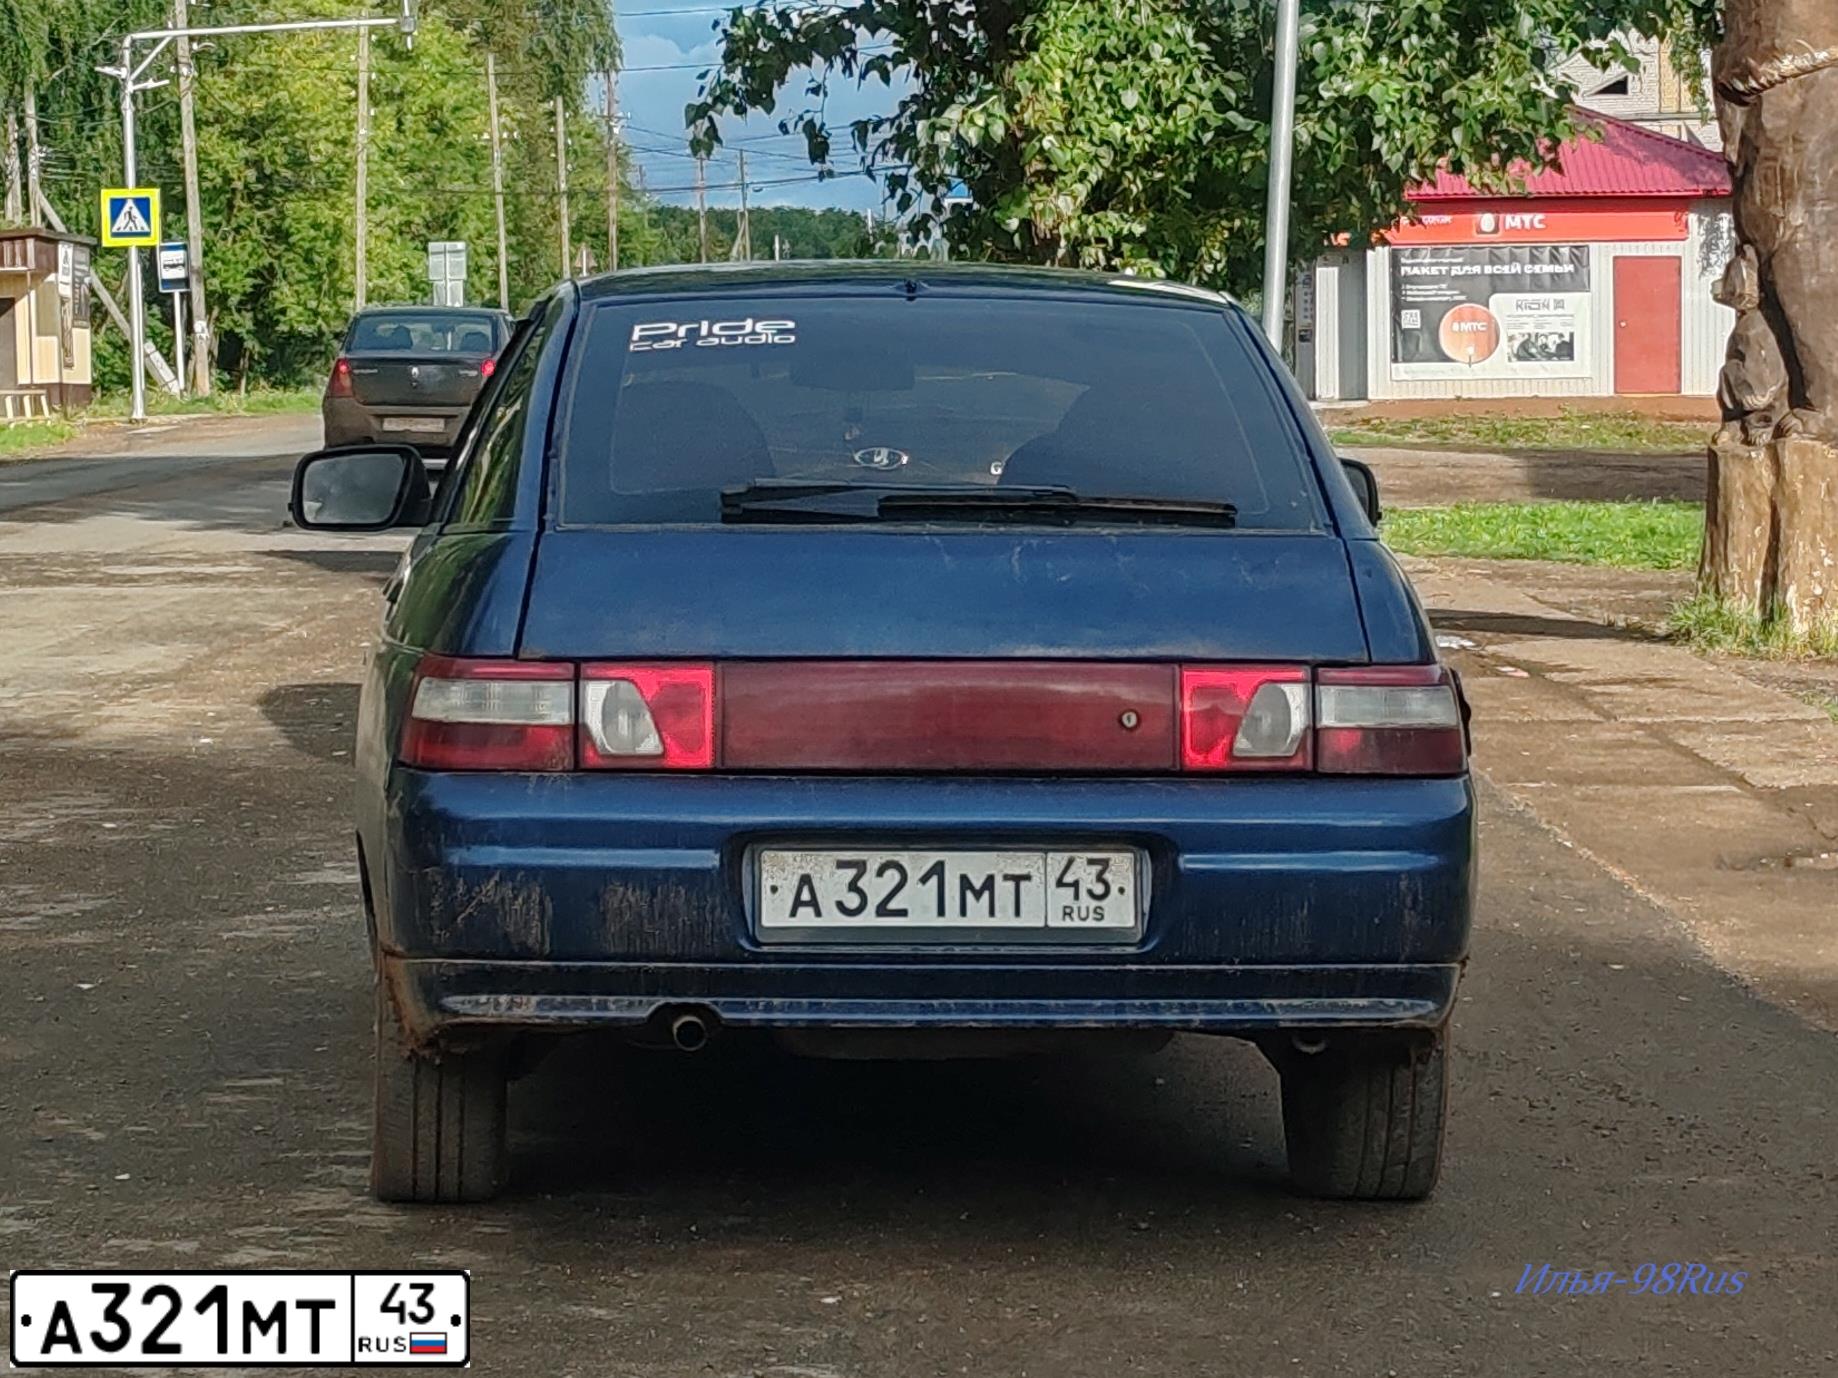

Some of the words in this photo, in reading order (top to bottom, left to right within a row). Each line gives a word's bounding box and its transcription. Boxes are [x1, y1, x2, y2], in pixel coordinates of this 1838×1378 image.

[1505, 214, 1546, 229] МТС
[1400, 266, 1449, 276] ПАКЕТ
[1451, 265, 1482, 277] ДЛЯ
[1484, 263, 1522, 275] ВСЕЙ
[1524, 264, 1574, 275] СЕМЬИ
[631, 318, 796, 341] Pride
[1460, 321, 1488, 332] МТС
[629, 339, 688, 352] car
[696, 331, 796, 346] audio
[1055, 857, 1112, 901] 43
[788, 859, 1033, 919] А321МТ
[1062, 905, 1105, 922] RUS
